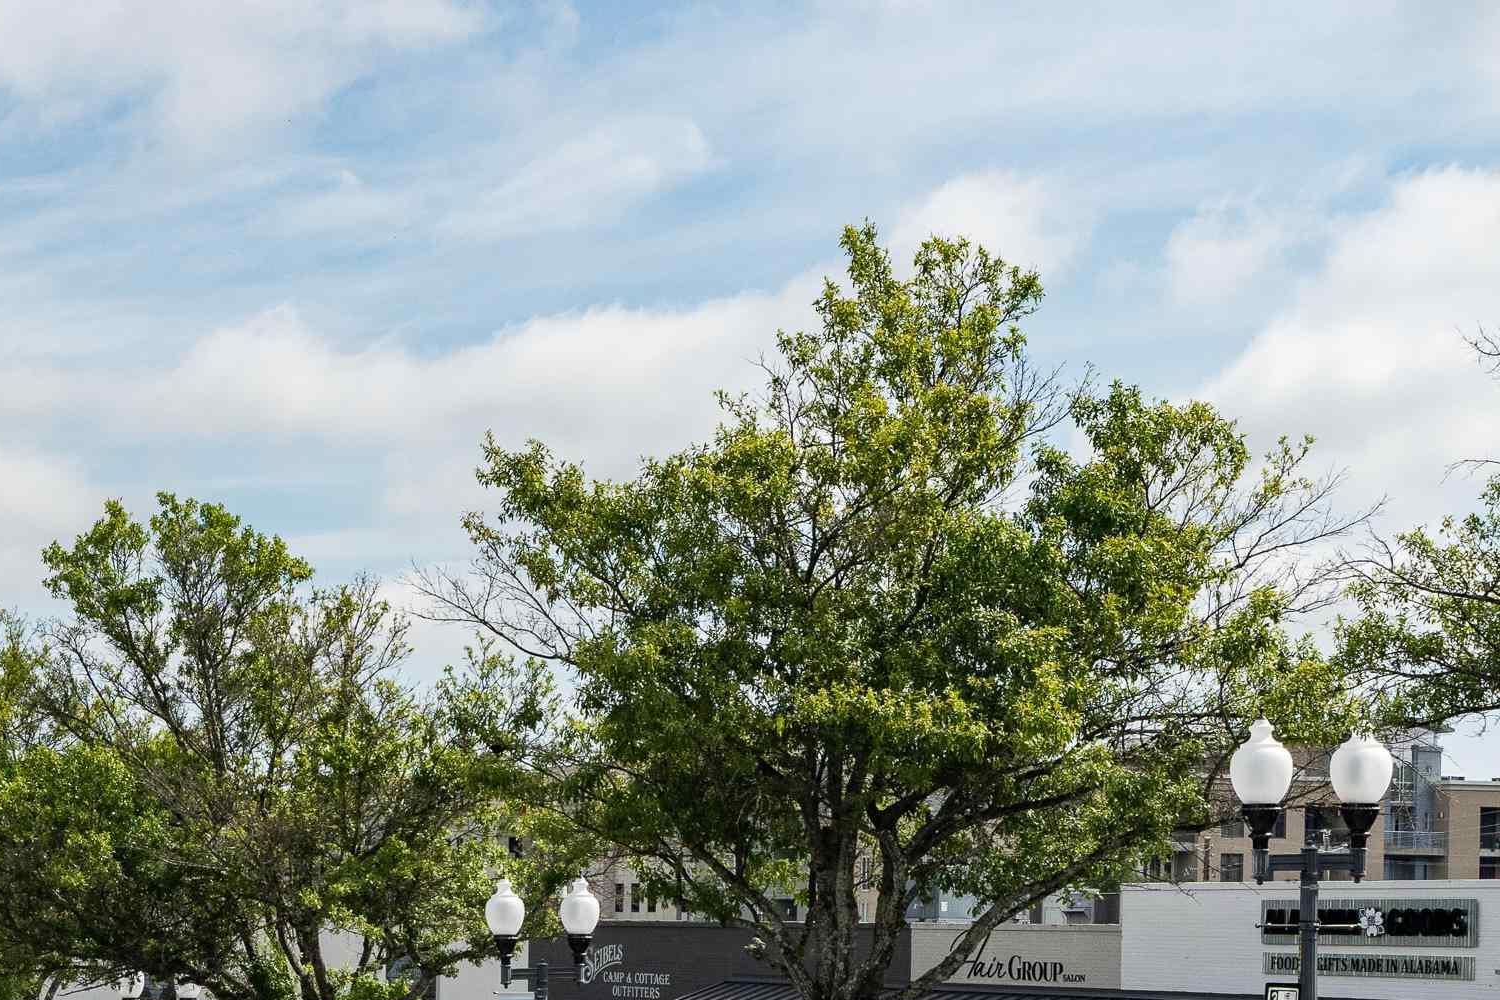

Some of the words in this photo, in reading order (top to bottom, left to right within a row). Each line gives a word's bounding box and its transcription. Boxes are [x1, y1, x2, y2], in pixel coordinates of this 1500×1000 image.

[580, 944, 623, 984] SEIBELS
[1008, 955, 1064, 982] GROUP
[1063, 974, 1086, 982] SALON
[1317, 957, 1348, 972] GIFTS
[1350, 958, 1383, 973] MADE
[1385, 960, 1398, 974] IN
[1400, 960, 1460, 975] ALABAMA
[603, 971, 625, 983] CAMP
[626, 972, 632, 983] &
[634, 973, 671, 985] COTTAGE
[612, 985, 660, 999] OUTFITTERS
